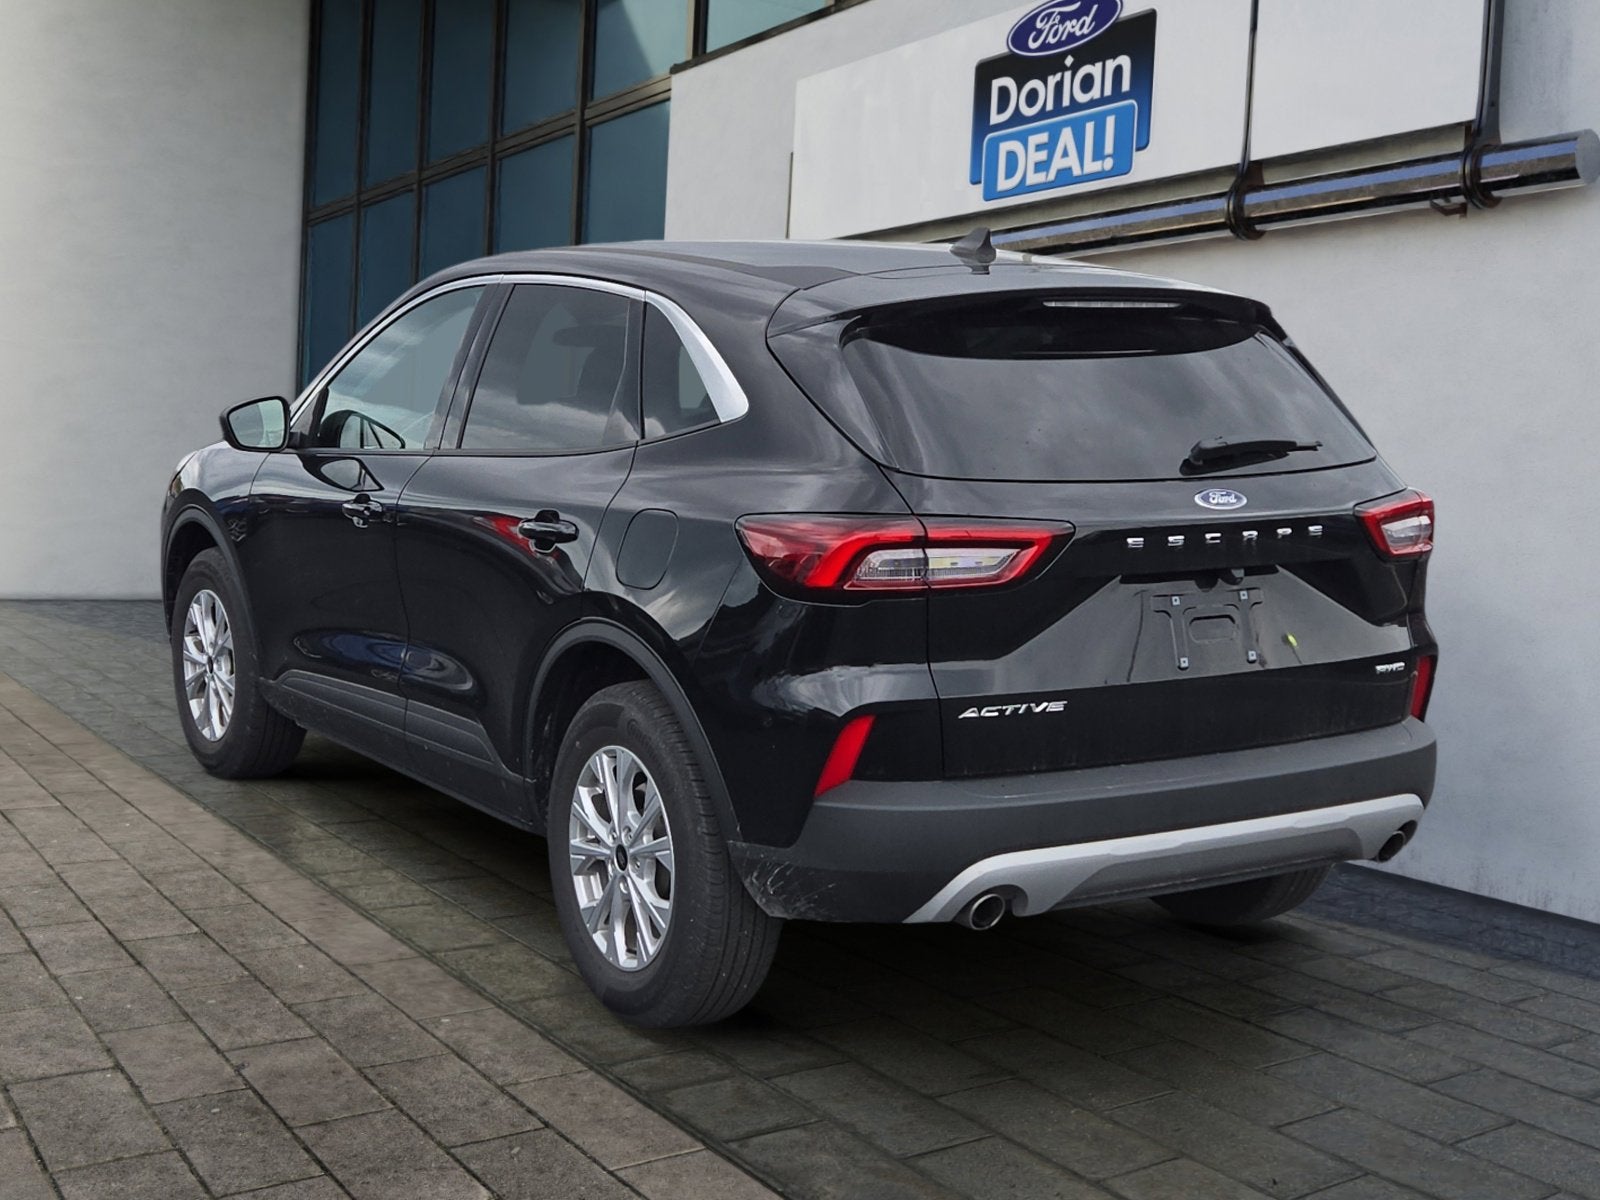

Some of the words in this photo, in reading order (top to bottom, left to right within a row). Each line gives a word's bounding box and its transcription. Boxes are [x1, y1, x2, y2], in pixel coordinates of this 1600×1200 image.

[1027, 1, 1099, 50] Ford
[989, 54, 1132, 126] Dorian
[996, 114, 1116, 192] DEAL!
[1126, 525, 1323, 548] ESCAPE
[958, 700, 1068, 719] ACTIVE
